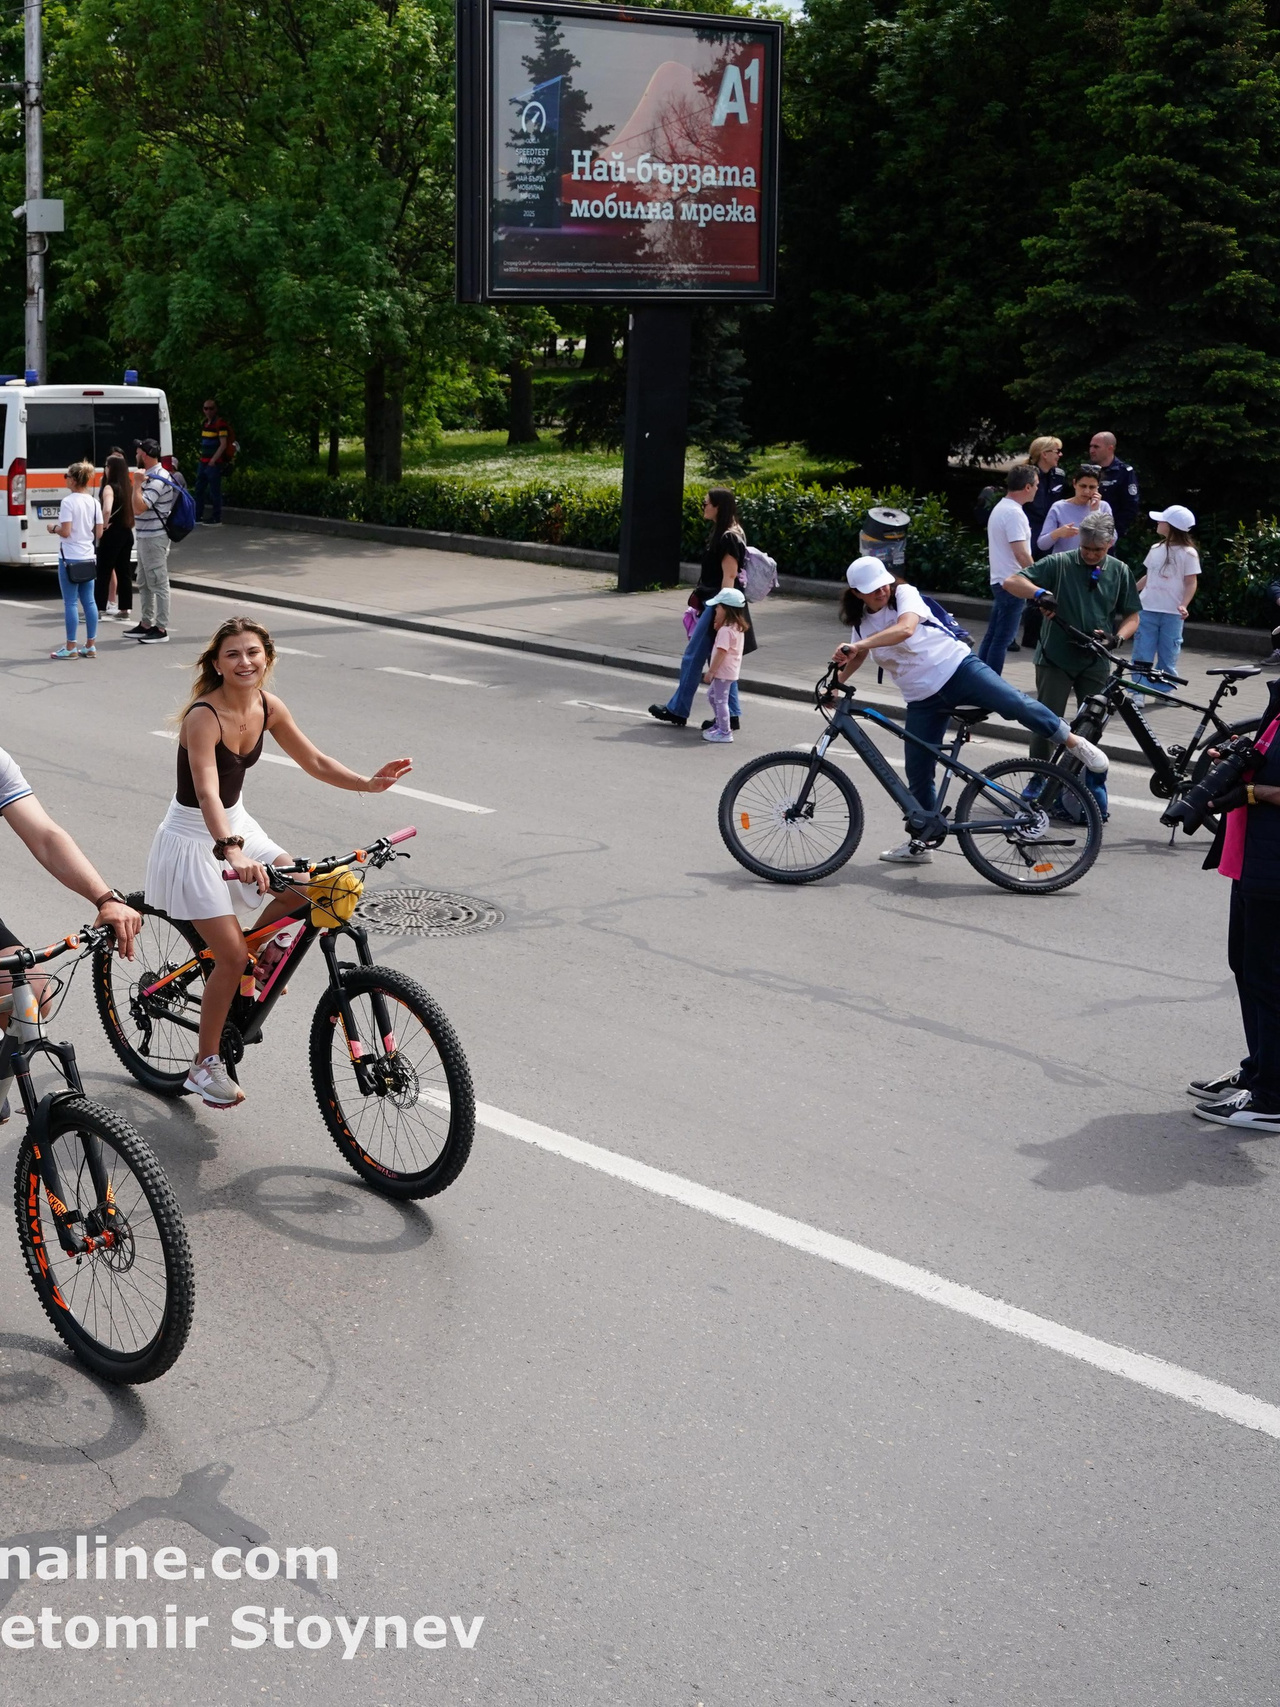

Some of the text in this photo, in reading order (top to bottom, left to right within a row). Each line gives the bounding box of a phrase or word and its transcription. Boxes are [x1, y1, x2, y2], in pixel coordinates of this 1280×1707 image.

[712, 58, 760, 127] A1
[515, 148, 550, 156] SPEEDTEST
[518, 157, 546, 165] AWARDS
[571, 149, 757, 194] Най-бързата
[570, 192, 757, 227] мобилна мрежа
[1131, 702, 1161, 747] OMEGA
[19, 1149, 33, 1243] MAGIC MARY
